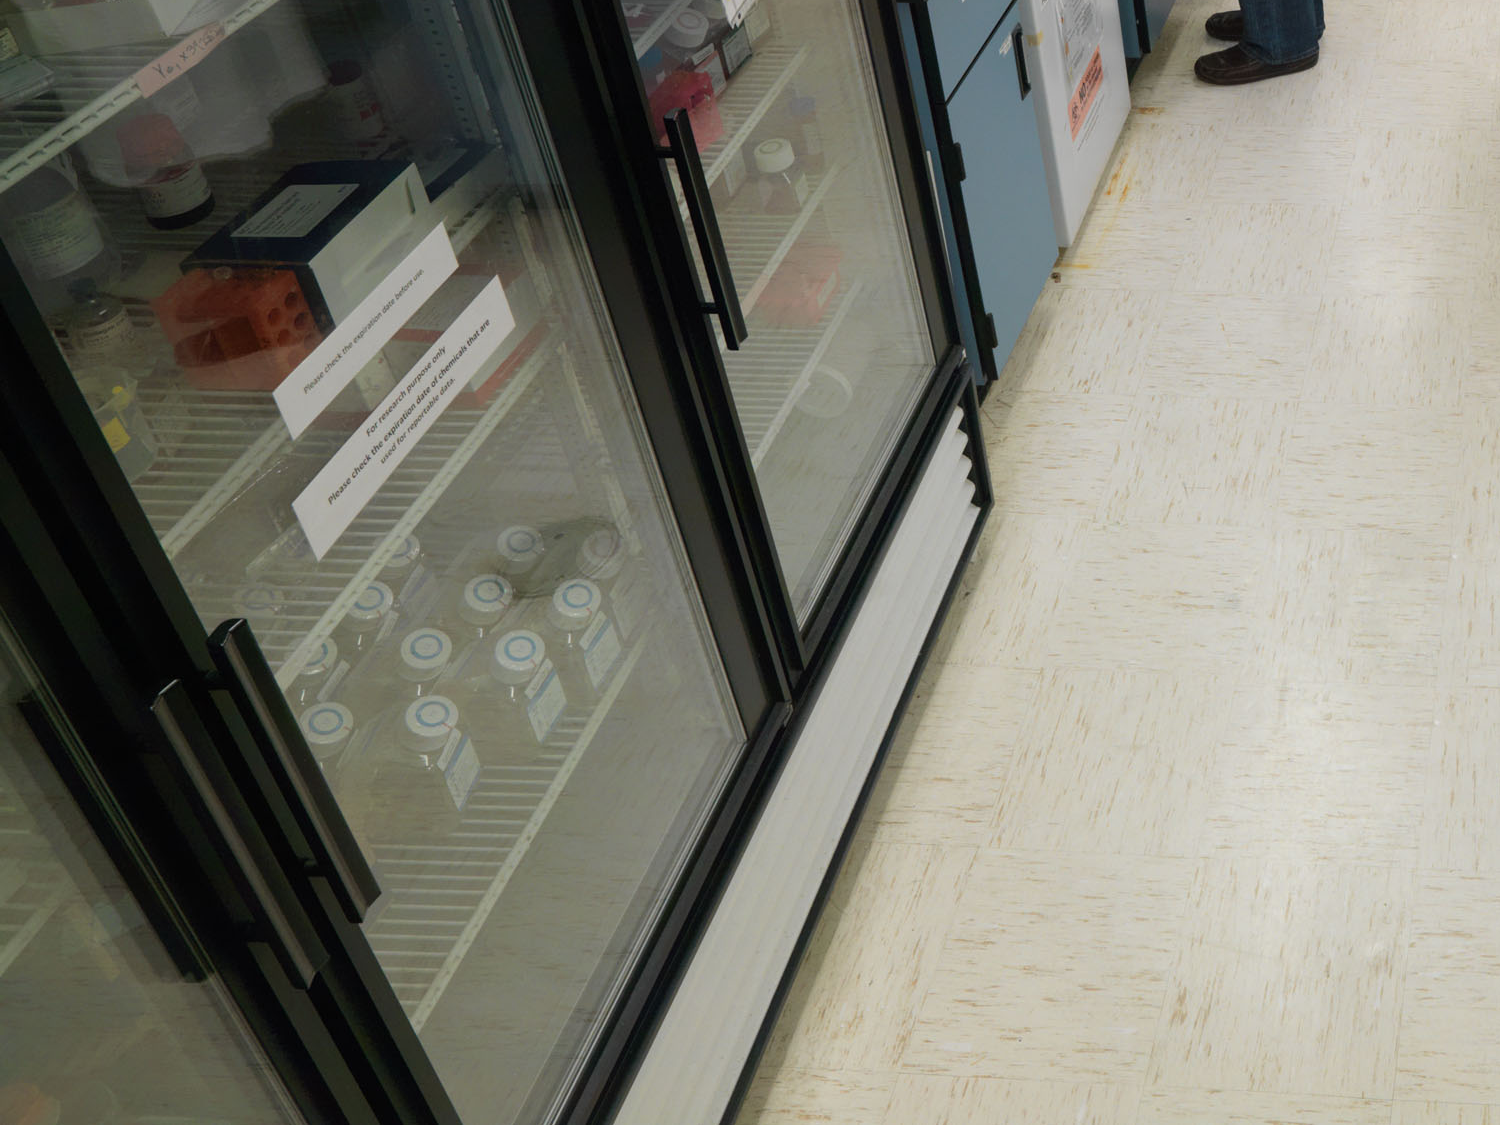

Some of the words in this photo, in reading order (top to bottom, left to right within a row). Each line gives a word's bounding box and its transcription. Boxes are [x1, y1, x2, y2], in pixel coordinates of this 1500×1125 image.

[302, 371, 324, 395] Please
[323, 353, 343, 374] check
[340, 341, 353, 355] the
[352, 312, 383, 344] expiration
[380, 298, 395, 314] date
[393, 279, 413, 301] before
[411, 269, 423, 282] use.
[326, 477, 352, 506] Please
[350, 454, 372, 479] check
[369, 440, 384, 456] the
[382, 403, 417, 443] expiration
[414, 386, 432, 405] date
[429, 375, 439, 388] of
[437, 344, 468, 380] chemicals
[465, 330, 481, 347] that
[478, 318, 491, 333] are
[364, 421, 378, 438] For
[377, 390, 407, 424] research
[405, 362, 433, 395] purpose
[430, 346, 446, 364] only
[379, 442, 397, 465] used
[395, 431, 407, 446] for
[405, 394, 440, 434] reportable
[438, 378, 456, 396] data.
